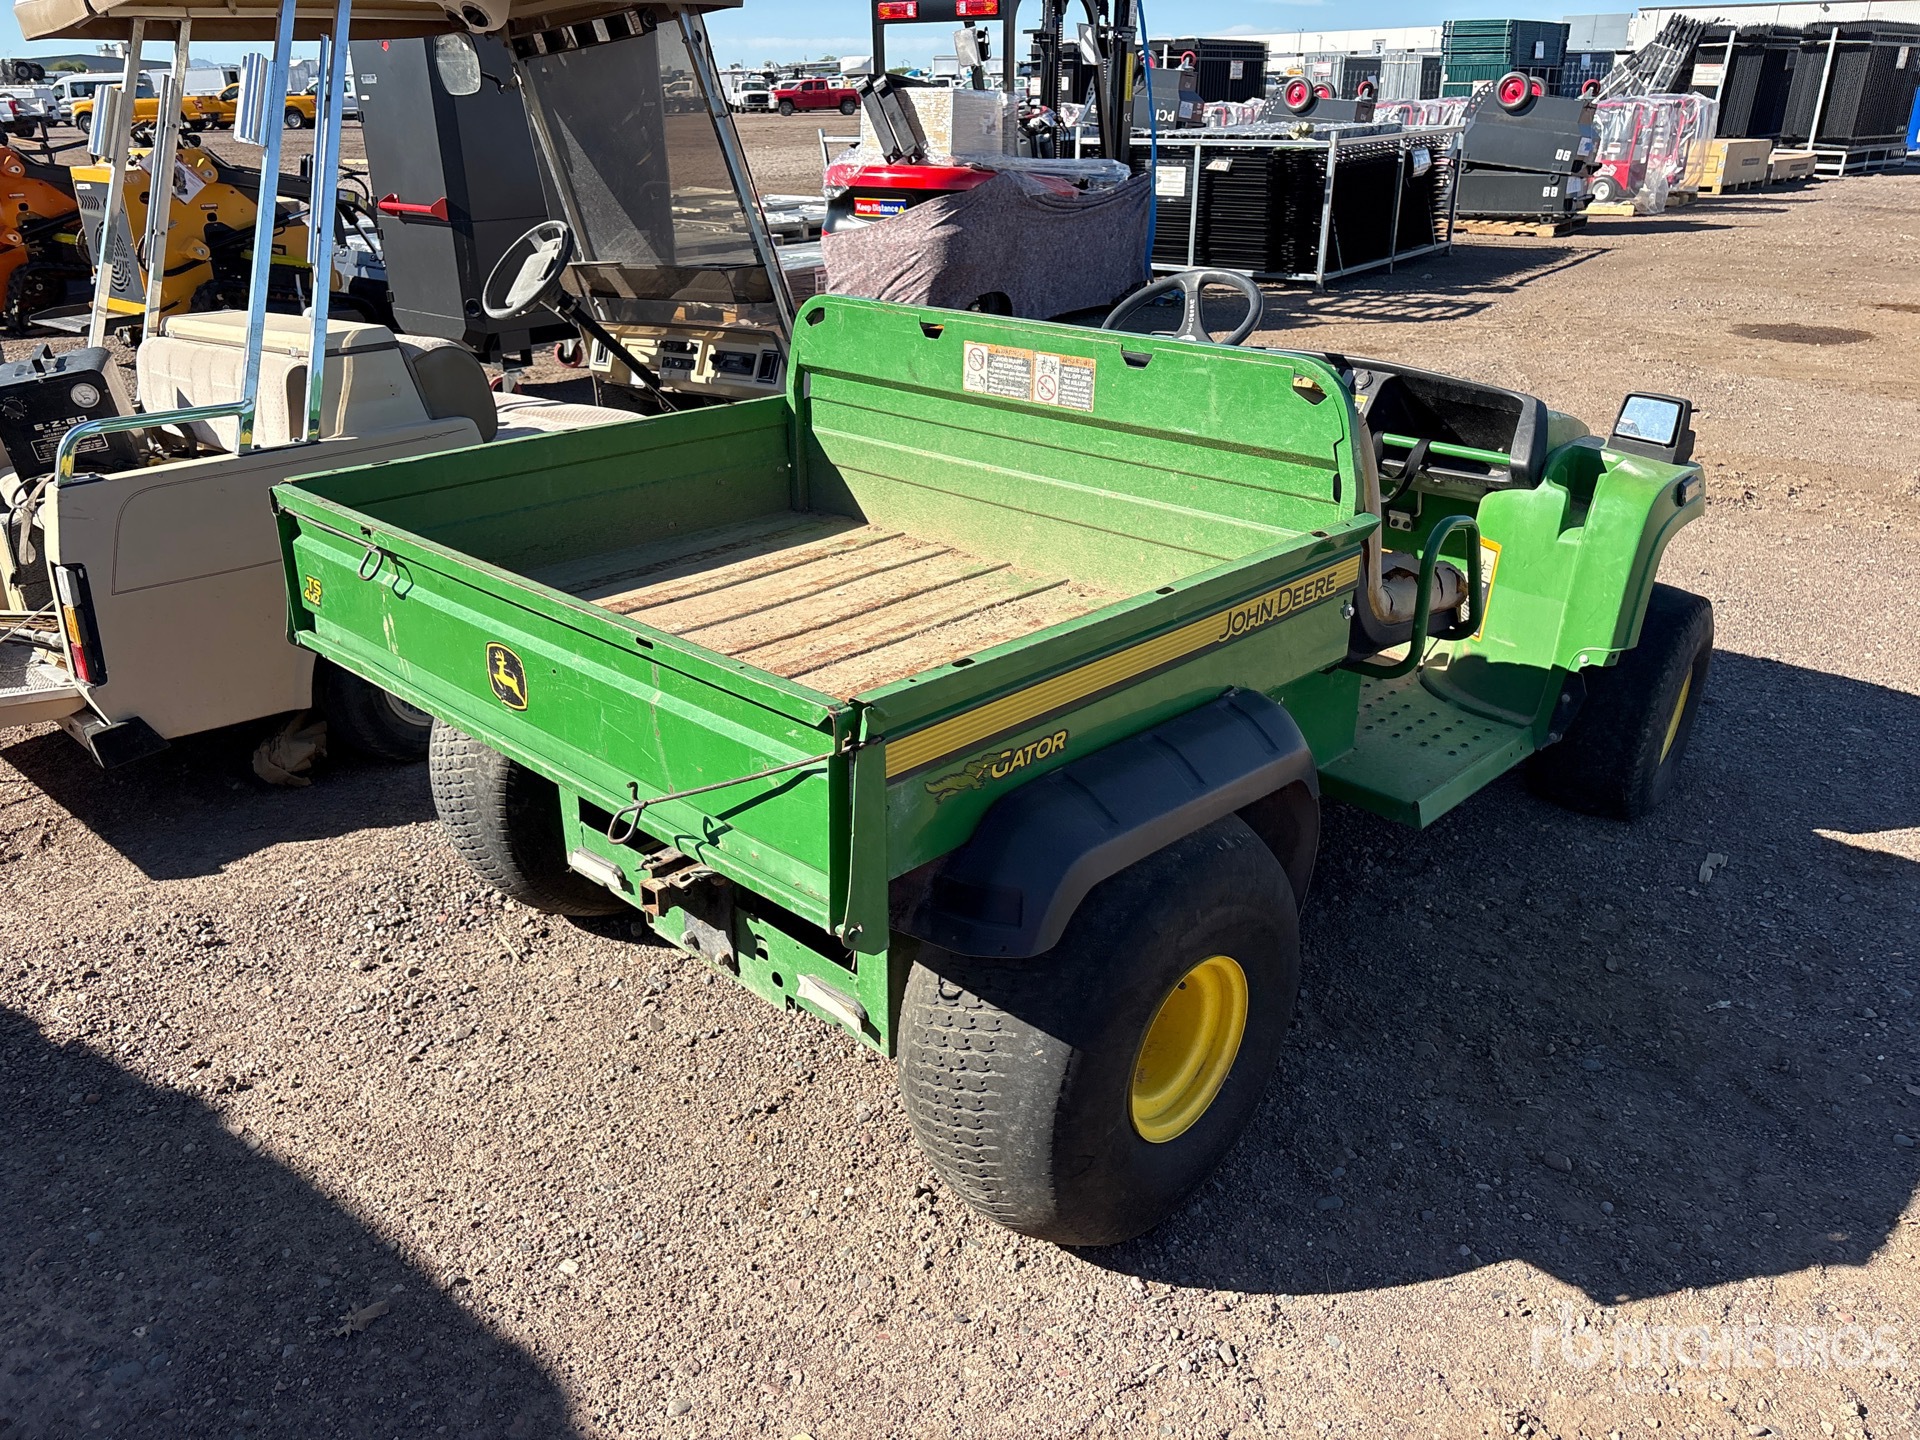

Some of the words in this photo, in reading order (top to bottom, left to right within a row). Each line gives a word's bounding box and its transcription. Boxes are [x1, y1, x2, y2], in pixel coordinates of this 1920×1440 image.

[1155, 108, 1176, 122] PCI
[856, 202, 872, 213] Keep
[872, 203, 899, 213] Distance
[33, 415, 88, 431] E-Z-GO
[306, 575, 321, 596] TS
[1218, 598, 1275, 642] JOHN
[1277, 570, 1339, 617] DEERE
[990, 729, 1068, 780] GATOR
